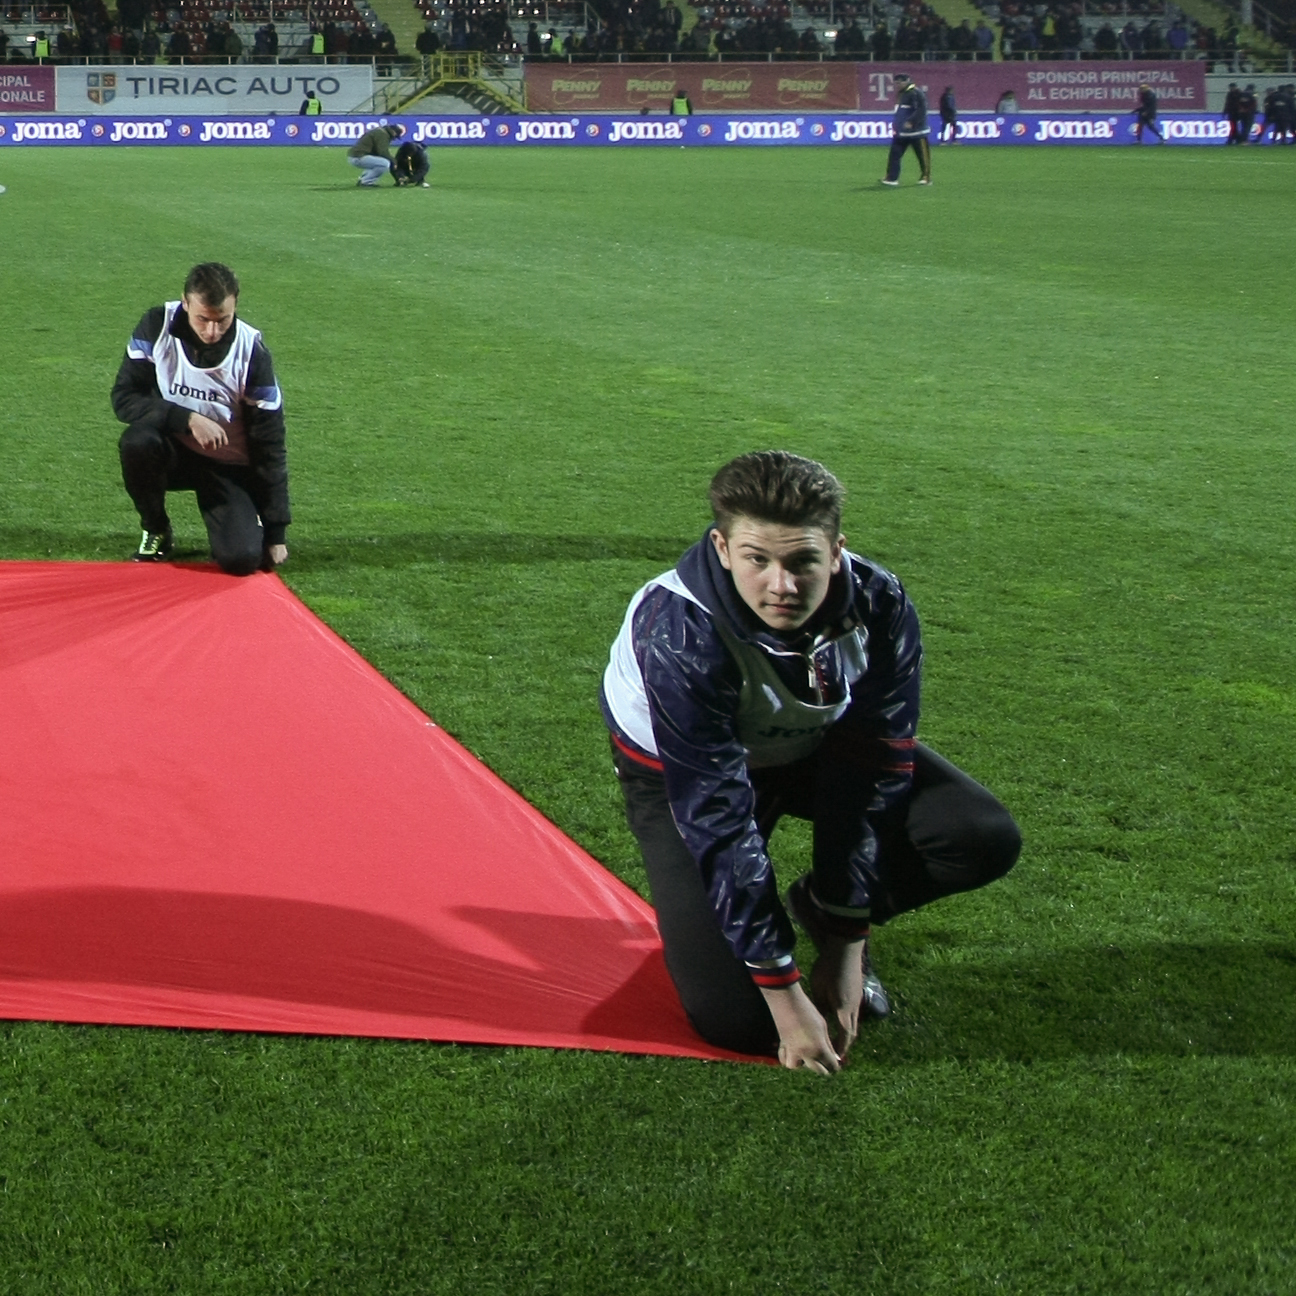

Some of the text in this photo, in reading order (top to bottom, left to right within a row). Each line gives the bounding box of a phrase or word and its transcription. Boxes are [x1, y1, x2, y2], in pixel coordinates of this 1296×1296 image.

[1027, 71, 1179, 84] SPONSOR PRINCIPAL
[246, 77, 340, 96] AUTO
[552, 79, 601, 92] PENNY
[626, 79, 676, 92] PENNY
[702, 78, 752, 91] PENNY
[777, 78, 829, 91] PENNY
[1028, 87, 1046, 100] AL
[1052, 87, 1108, 100] ECHIPEI
